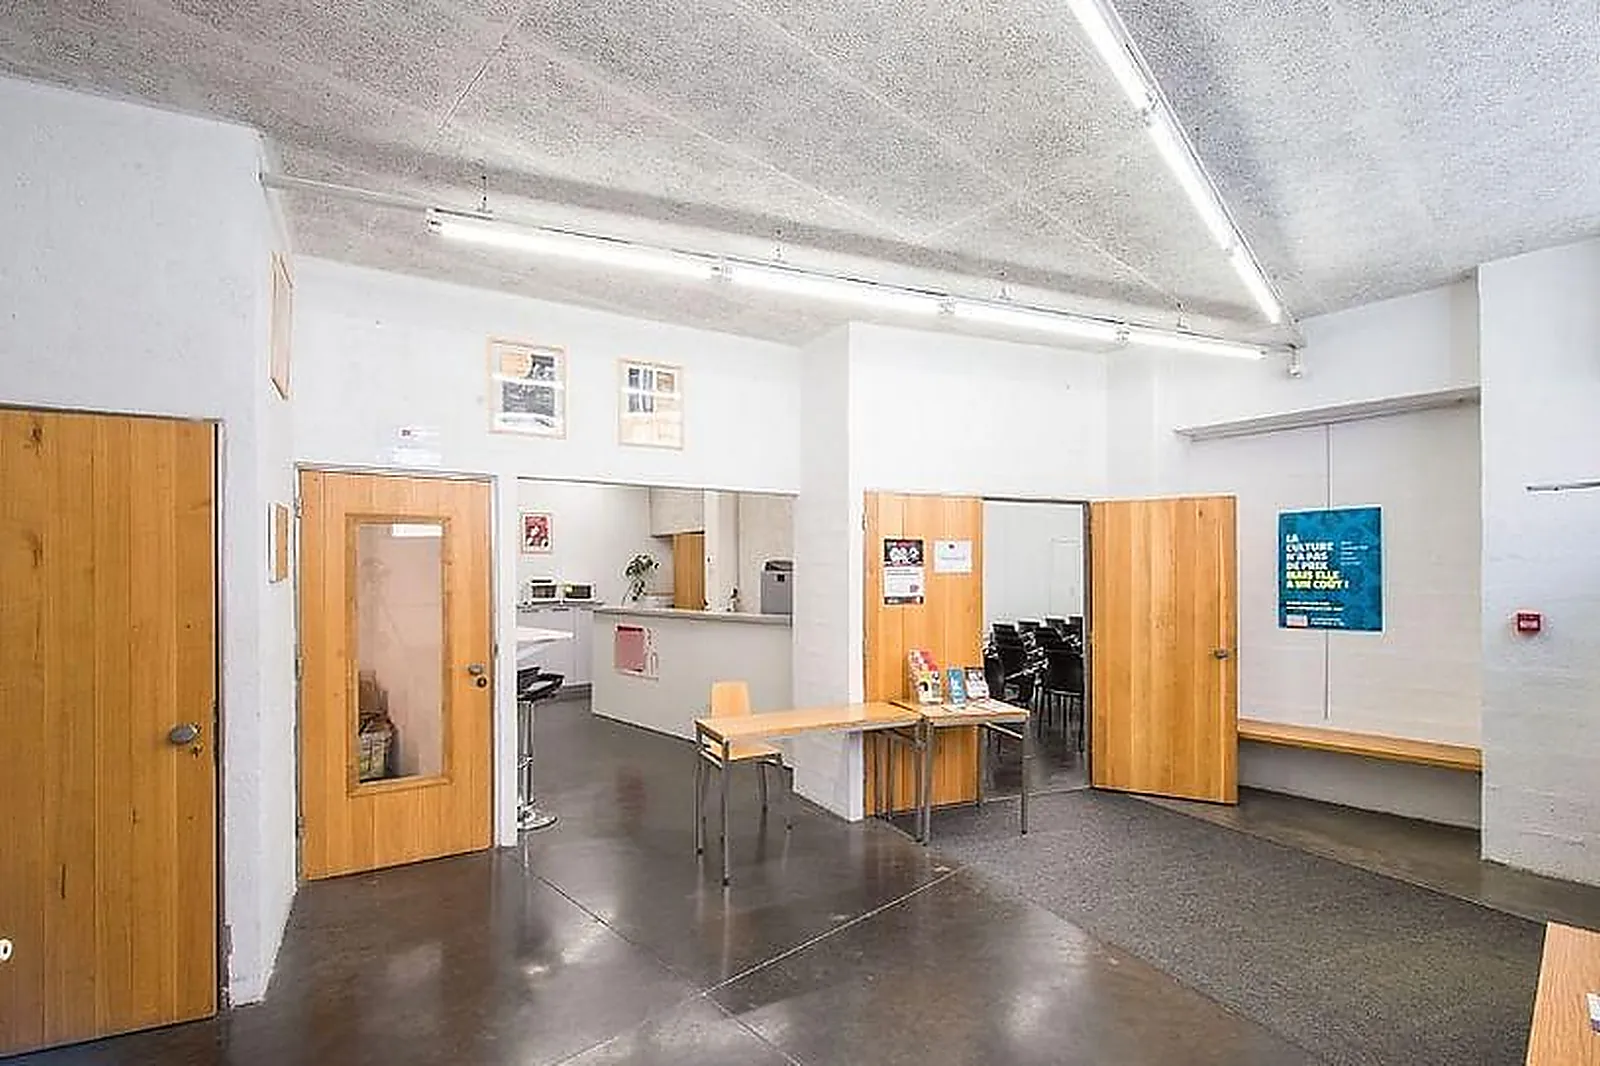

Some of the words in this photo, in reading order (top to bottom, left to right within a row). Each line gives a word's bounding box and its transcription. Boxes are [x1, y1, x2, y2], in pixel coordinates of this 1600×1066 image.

[1286, 533, 1299, 543] LA
[1286, 542, 1334, 552] CULTURE
[1306, 551, 1329, 561] PAS
[1286, 561, 1299, 570] DE
[1301, 561, 1328, 570] PRIX
[1315, 570, 1340, 580] ELLE
